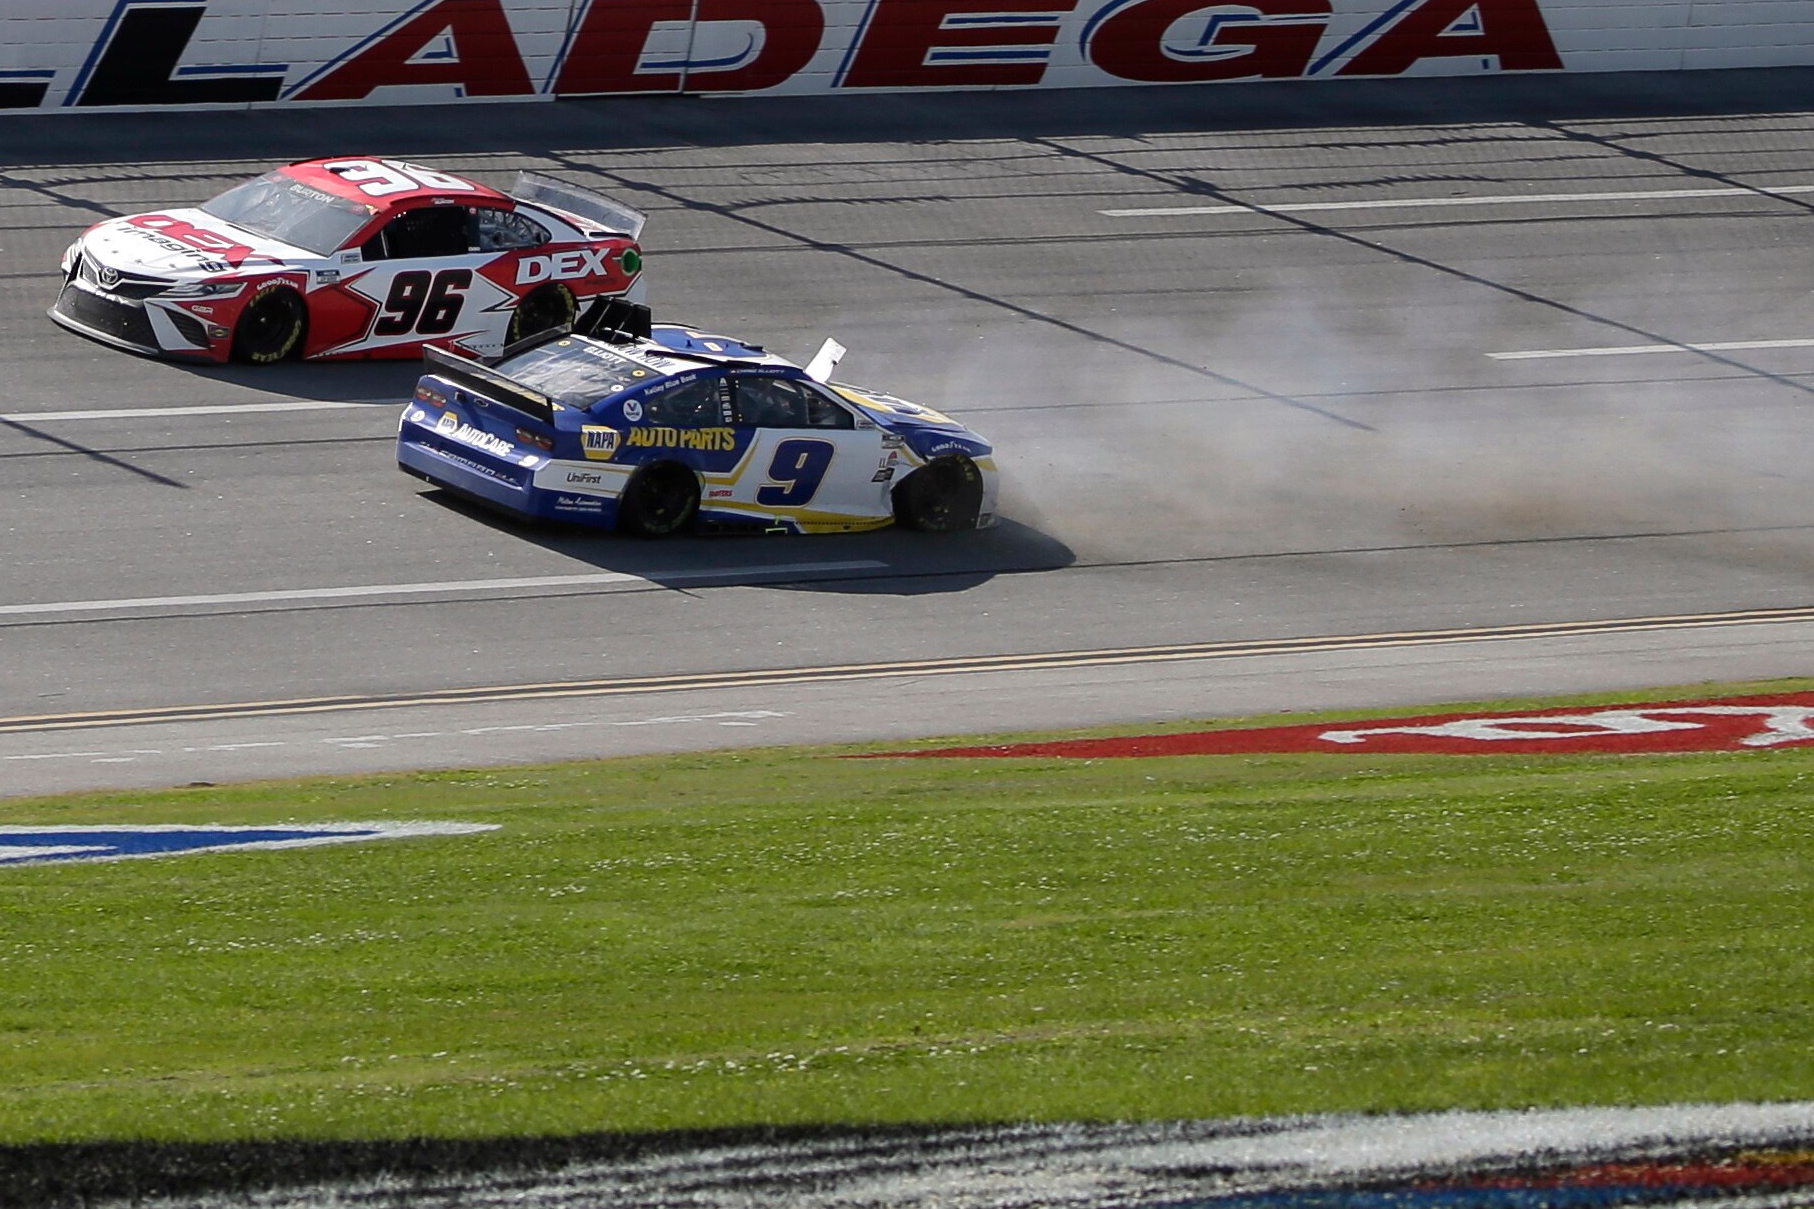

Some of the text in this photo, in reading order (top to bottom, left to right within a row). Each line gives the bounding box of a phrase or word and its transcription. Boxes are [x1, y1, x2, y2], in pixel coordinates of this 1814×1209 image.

[323, 159, 475, 197] 96
[289, 184, 335, 203] BURTON
[117, 226, 227, 273] imaging
[515, 248, 611, 285] DEX
[256, 277, 299, 291] GOODYEAR
[373, 269, 474, 337] 96
[584, 346, 628, 364] ELLIOTT
[586, 430, 616, 449] NAPA
[625, 426, 736, 452] AUTO PARTS
[566, 472, 603, 485] UniFirst
[753, 435, 836, 508] 9
